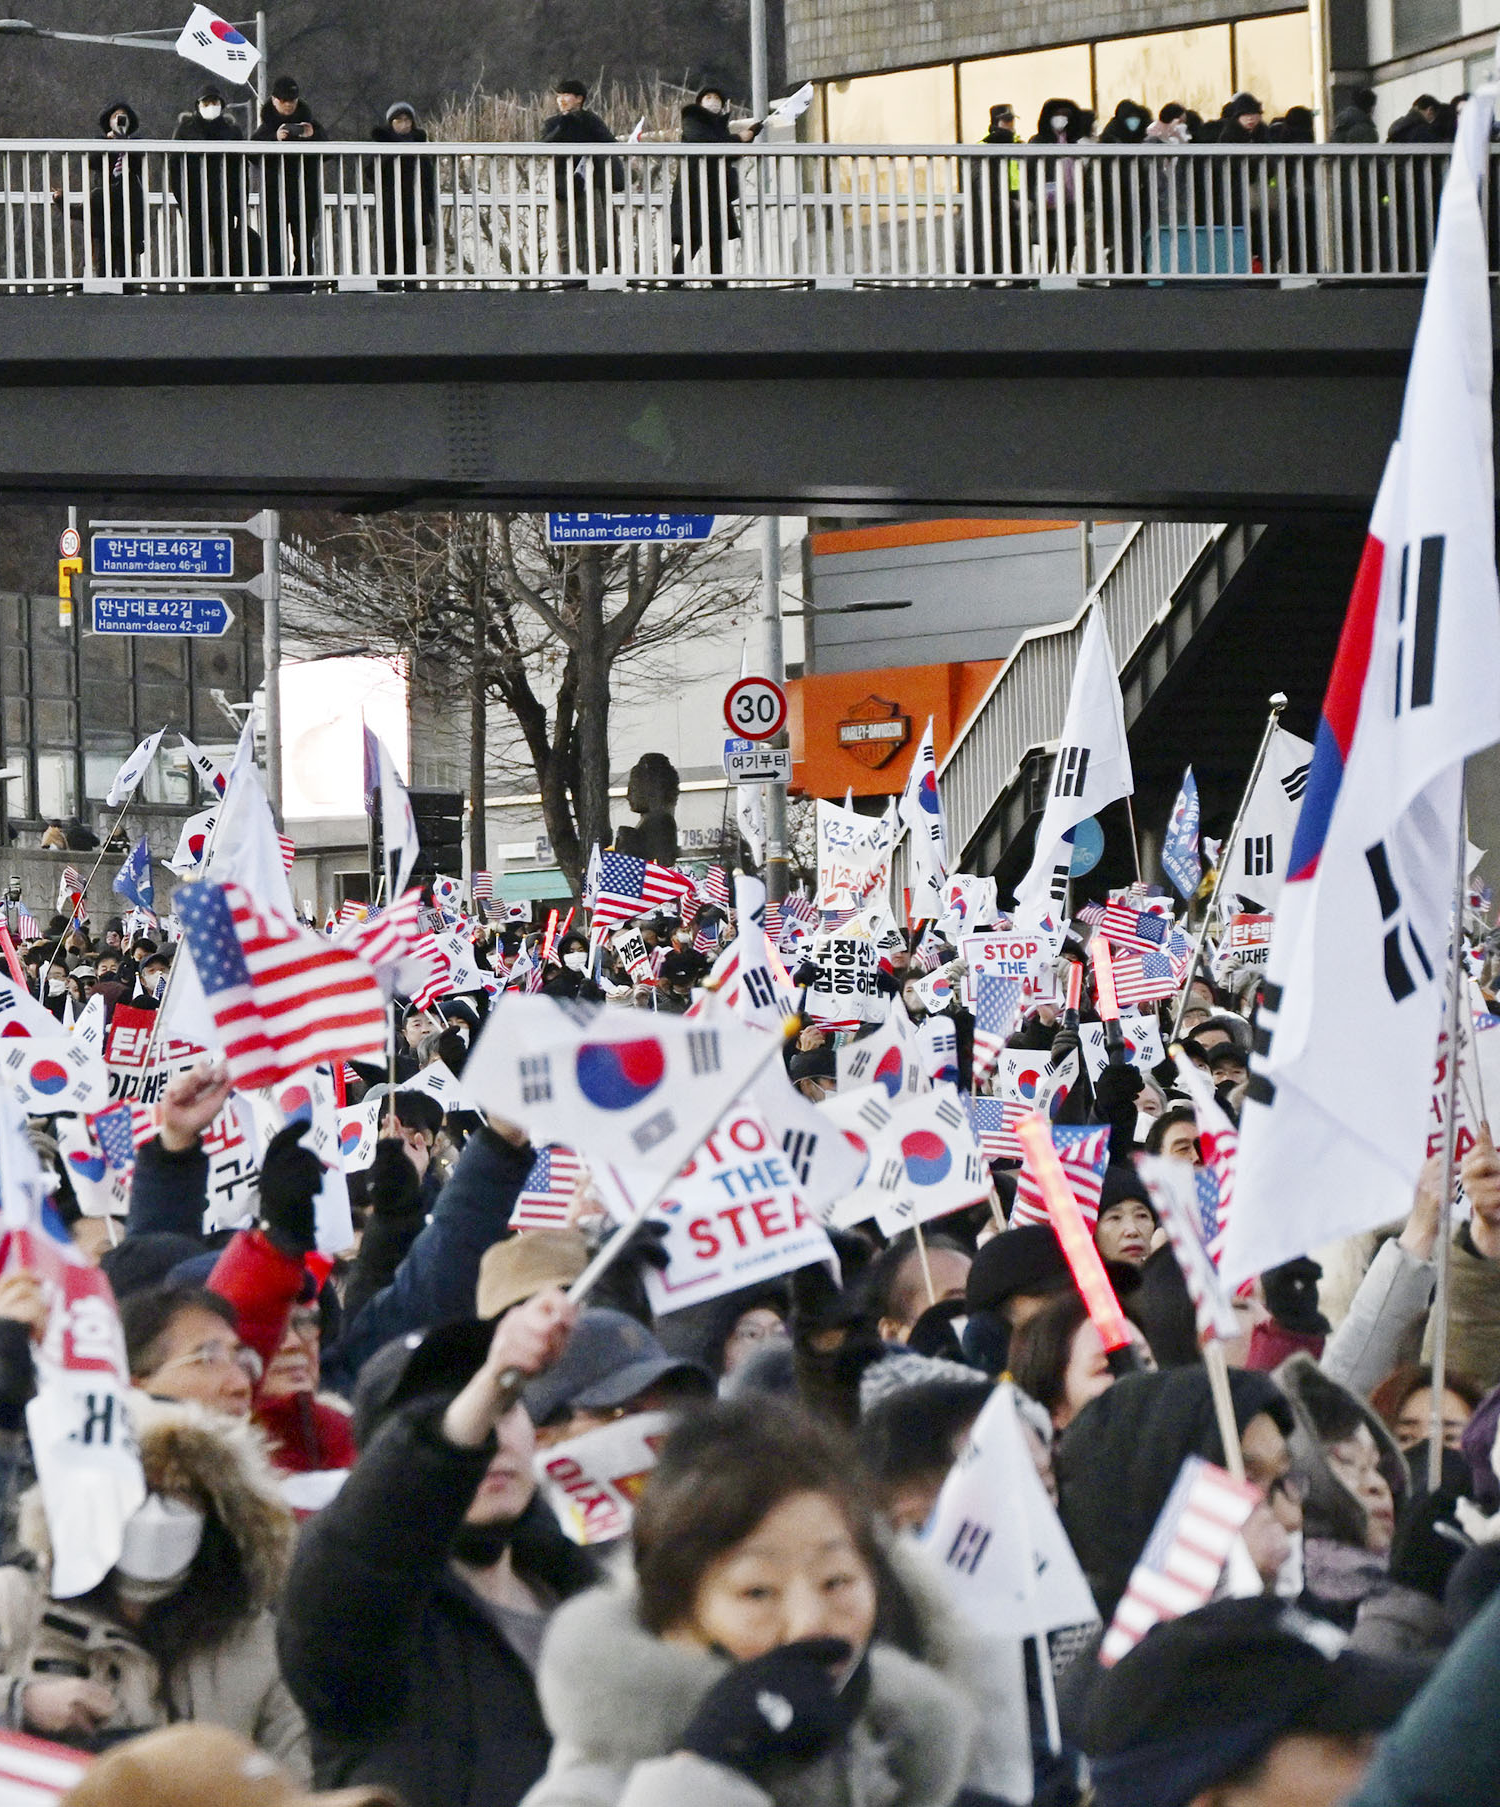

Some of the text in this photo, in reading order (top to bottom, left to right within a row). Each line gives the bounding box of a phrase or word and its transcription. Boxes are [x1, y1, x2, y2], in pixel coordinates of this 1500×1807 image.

[554, 523, 693, 538] Hannam-daero 40-gil
[108, 541, 202, 558] 한남대로46길
[103, 560, 177, 570] Hannam-daero
[178, 560, 207, 572] 46-gil
[99, 601, 193, 618] 한남대로42길
[99, 619, 210, 633] Hannam-daero 42-gil
[736, 694, 775, 724] 30
[732, 753, 787, 769] 여기부터
[1233, 922, 1272, 944] 탄핵
[815, 940, 874, 968] 부정선
[984, 943, 1038, 960] STOP
[998, 962, 1028, 974] THE
[711, 1156, 791, 1200] THE
[688, 1193, 815, 1261] STEA
